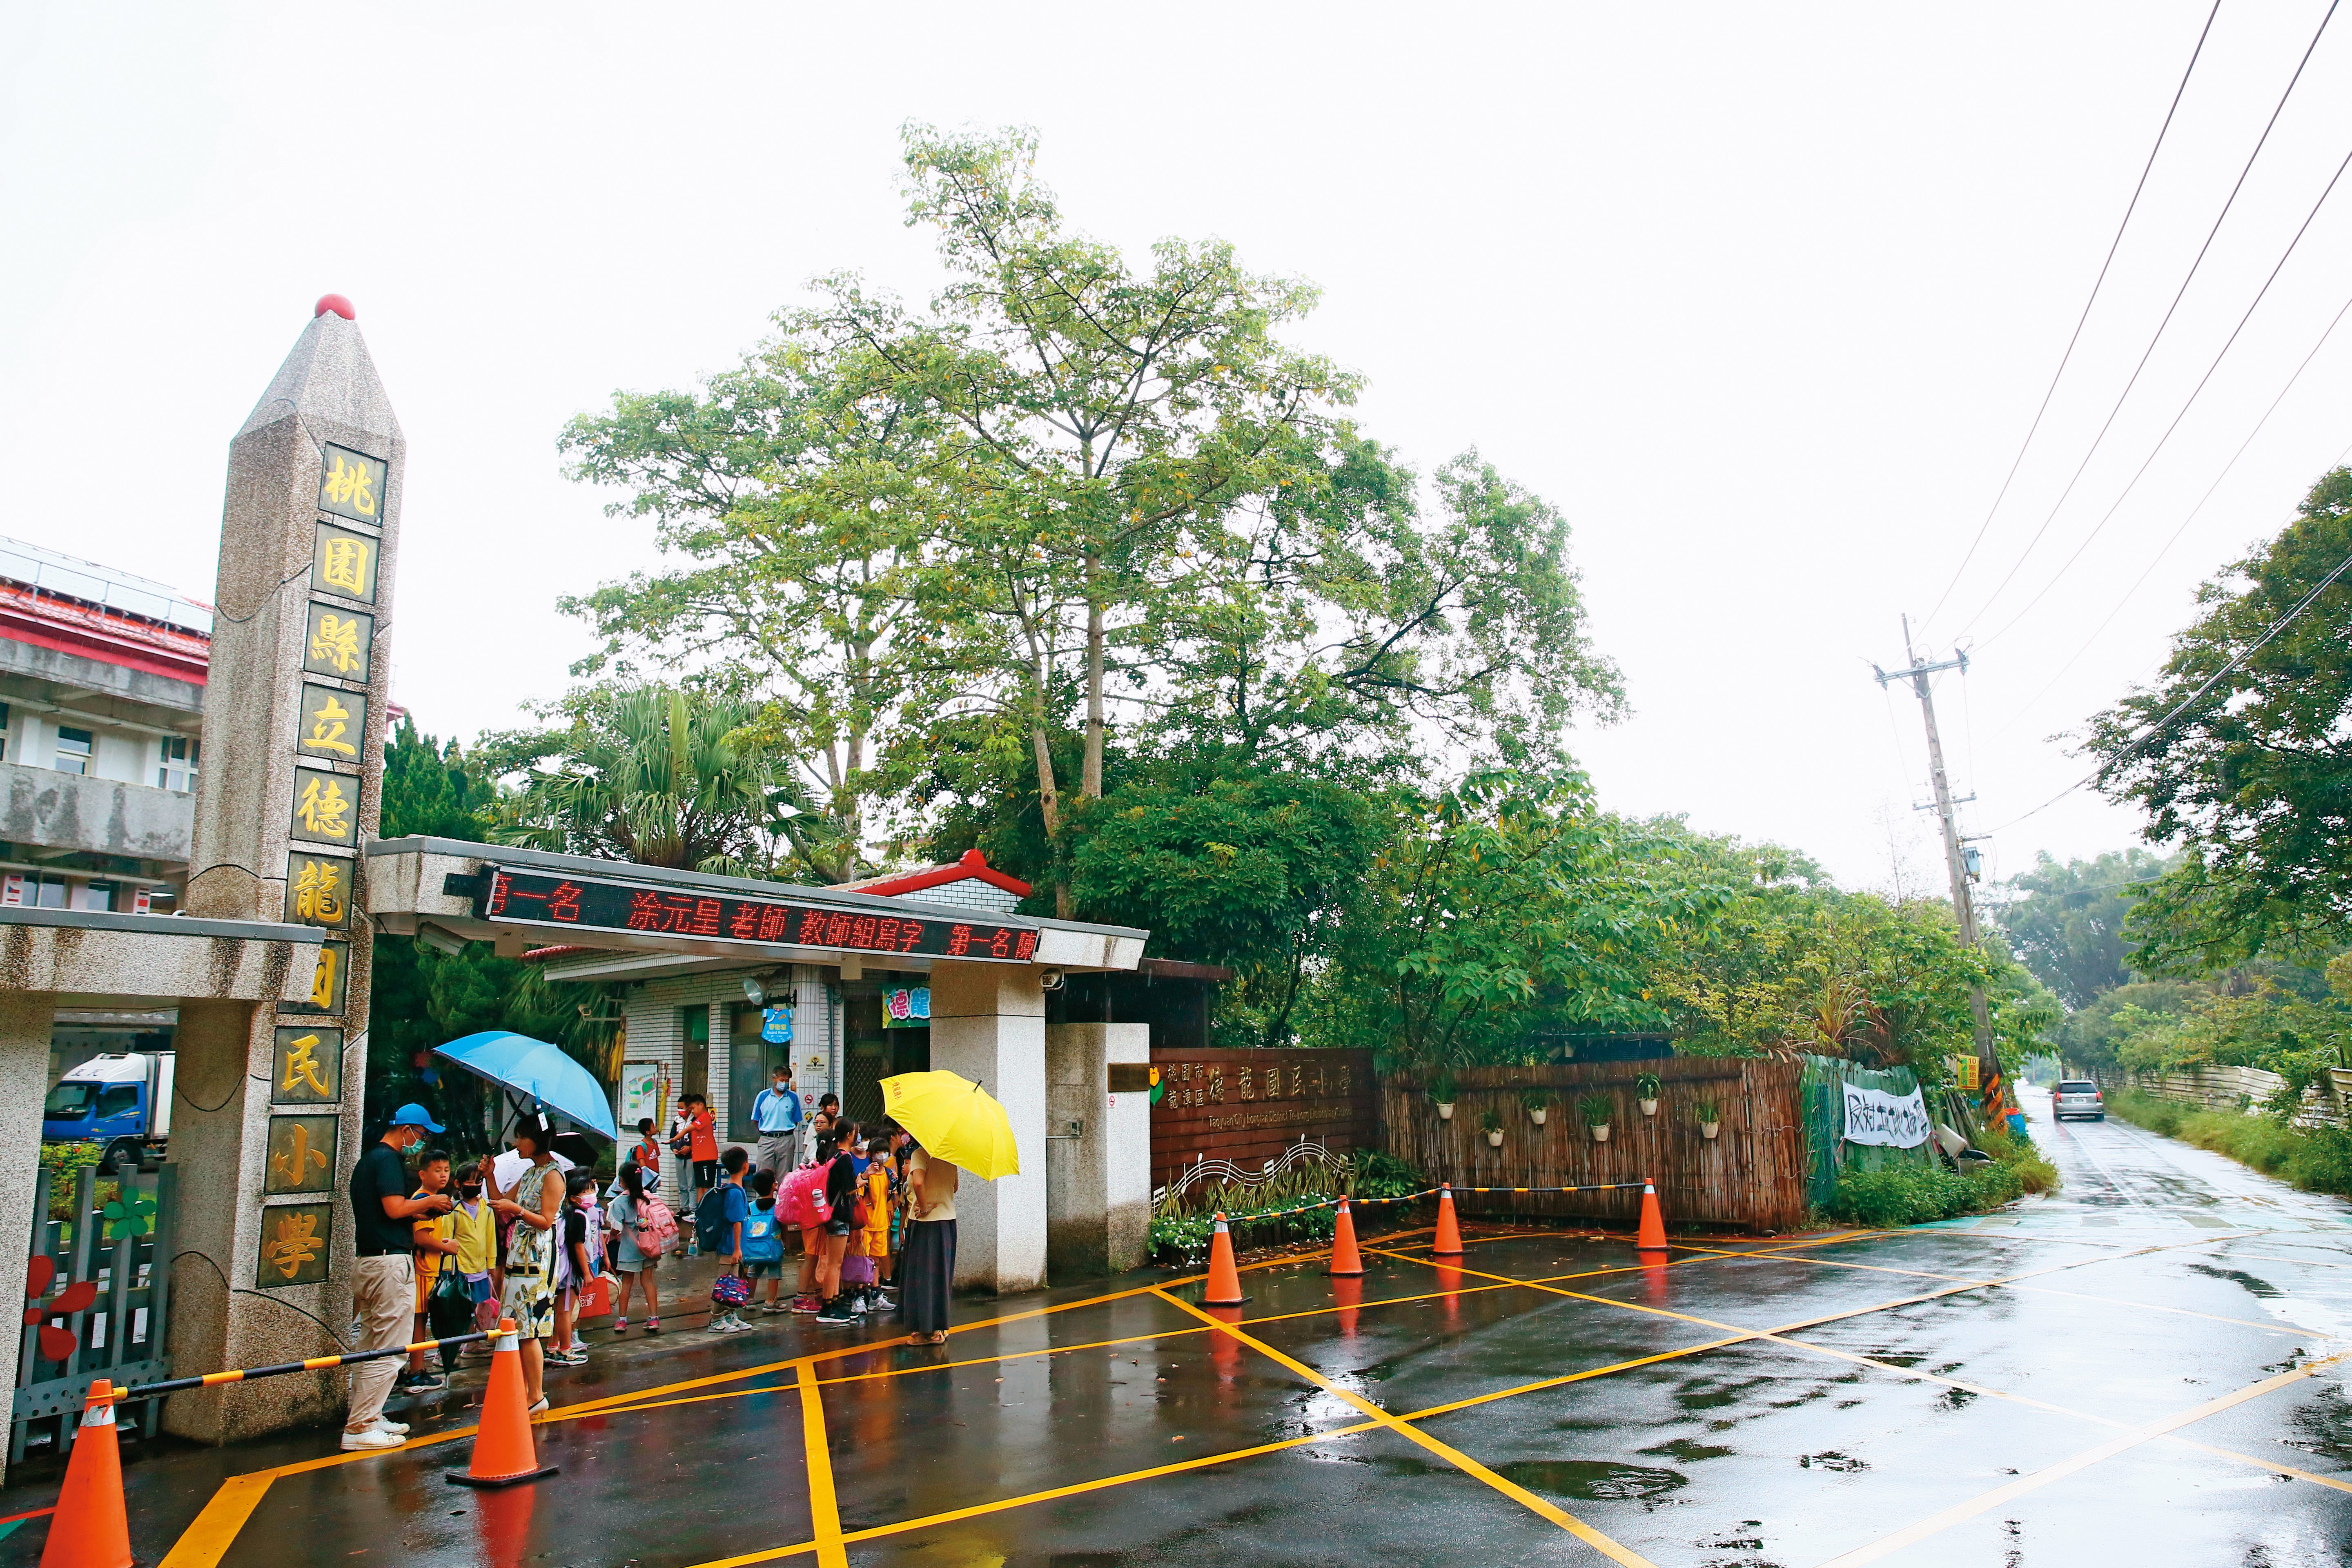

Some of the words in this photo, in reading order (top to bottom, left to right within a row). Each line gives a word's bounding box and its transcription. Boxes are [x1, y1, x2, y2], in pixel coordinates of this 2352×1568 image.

[800, 910, 923, 952] 教師組寫字
[889, 988, 931, 1019] 德龍
[1167, 1063, 1204, 1083] 桃園市
[1167, 1089, 1204, 1109] 龍潭區
[1209, 1115, 1234, 1129] Taoyuan
[1234, 1113, 1246, 1128] City
[1247, 1112, 1268, 1126] Longtan
[1269, 1110, 1287, 1123] District
